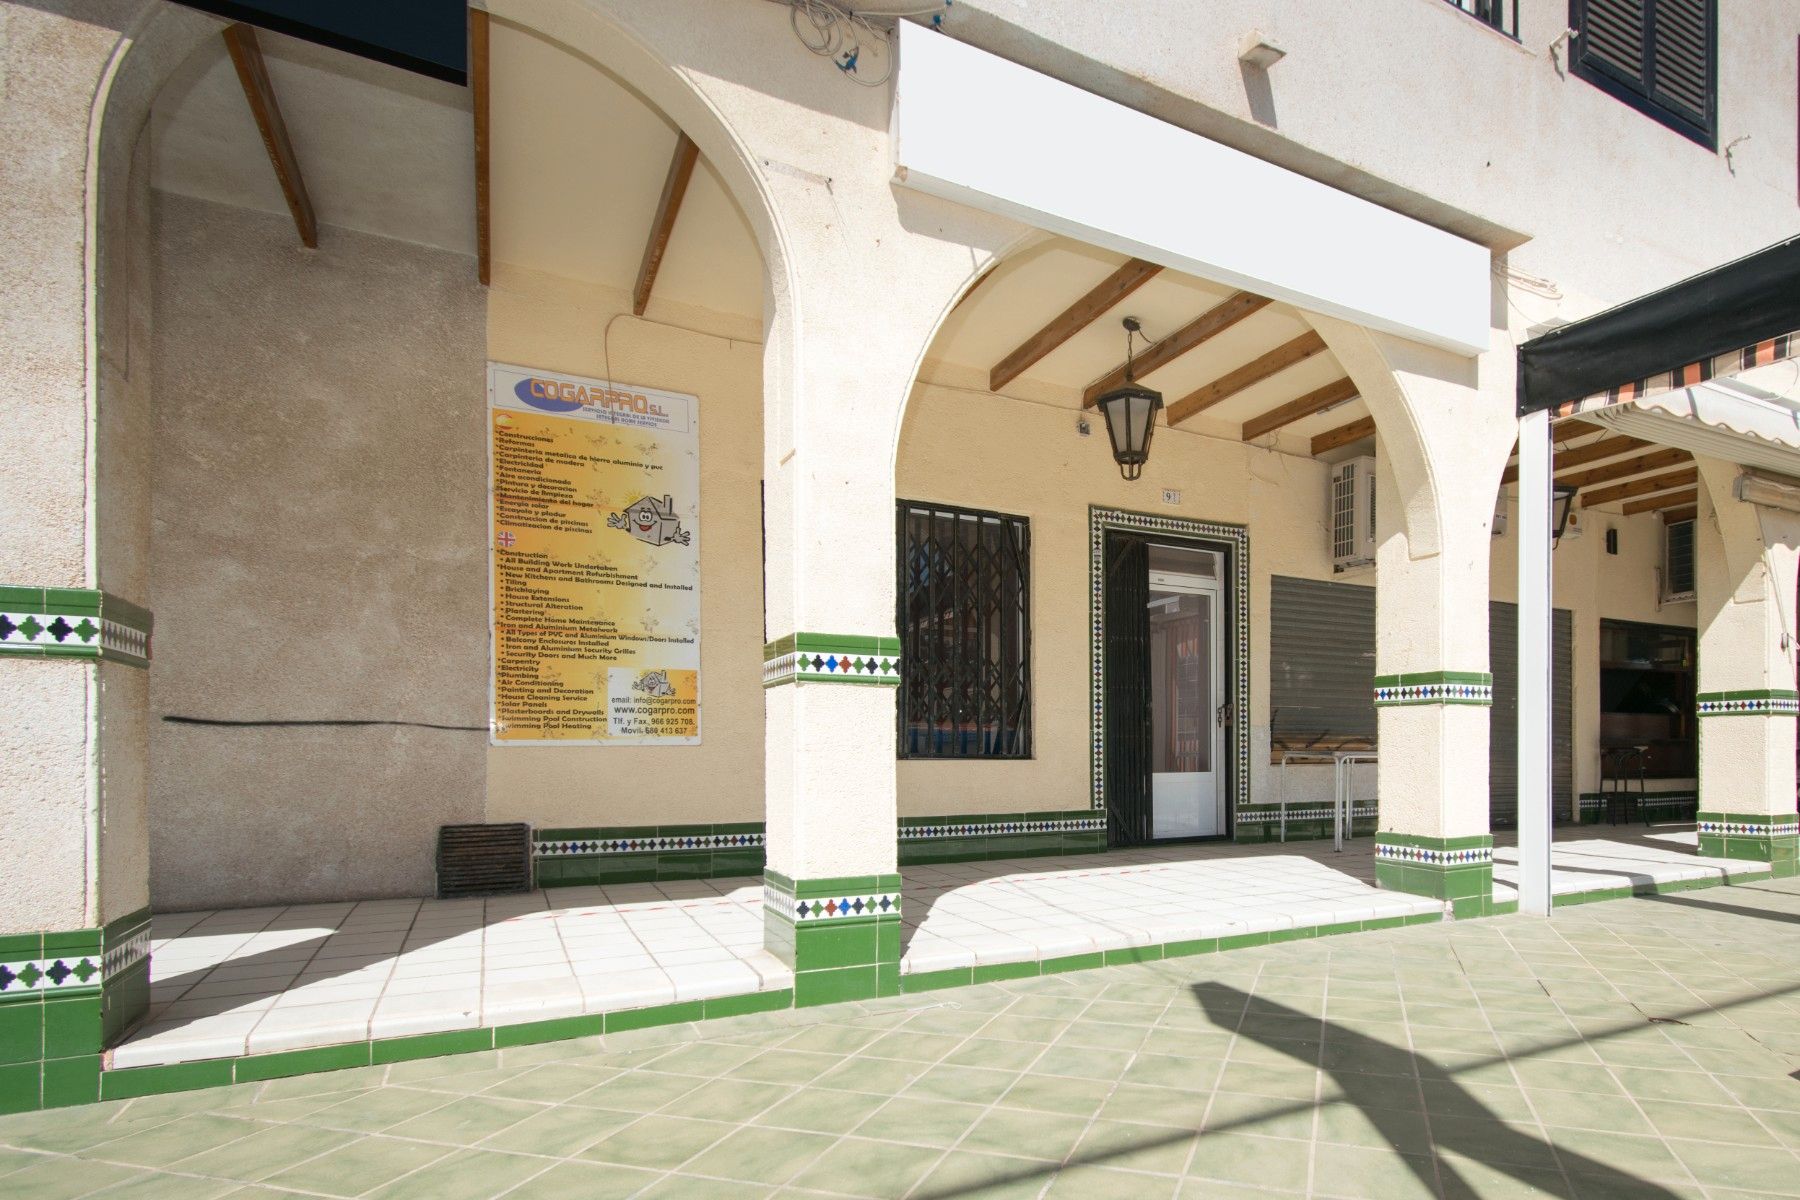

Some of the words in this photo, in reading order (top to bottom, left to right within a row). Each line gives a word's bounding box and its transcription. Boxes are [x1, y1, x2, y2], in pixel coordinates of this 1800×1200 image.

[530, 377, 647, 414] COGARPRO
[498, 430, 554, 443] Construcciones
[499, 438, 535, 447] Reformas
[499, 458, 544, 469] Electricidad
[556, 459, 584, 467] madera
[590, 456, 610, 464] hierro
[613, 459, 643, 468] aluminio
[500, 479, 529, 487] Pintura
[518, 475, 571, 485] acondicionado
[541, 490, 573, 498] limpieza
[500, 493, 557, 504] Mantenimiento
[572, 500, 594, 508] hogar
[500, 506, 532, 514] Escayola
[560, 519, 588, 527] piscinas
[564, 526, 592, 534] piscinas
[500, 549, 548, 559] Construction
[518, 558, 550, 567] Building
[574, 562, 618, 572] Undertaken
[543, 568, 583, 576] Apartment
[586, 570, 638, 580] Refurbishment
[505, 571, 523, 579] New
[525, 573, 556, 581] Kitchens
[574, 576, 614, 585] Bathrooms
[616, 580, 648, 588] Designed
[664, 583, 693, 591] Installed
[506, 578, 527, 586] Tiling
[505, 586, 550, 595] Bricklaying
[531, 594, 569, 603] Extensions
[505, 600, 543, 608] Structural
[545, 603, 583, 611] Alteration
[505, 608, 545, 616] Plastering
[506, 614, 542, 622] Complete
[569, 618, 615, 626] Maintenance
[536, 623, 577, 631] Aluminium
[506, 636, 536, 644] Balcony
[506, 650, 536, 658] Security
[584, 646, 612, 654] Security
[501, 658, 540, 666] Carpentry
[515, 680, 564, 688] Conditioning
[633, 697, 696, 705] info@cogarpro.com
[614, 707, 695, 716] www.cogarpro.com
[613, 717, 625, 725] Tlf.
